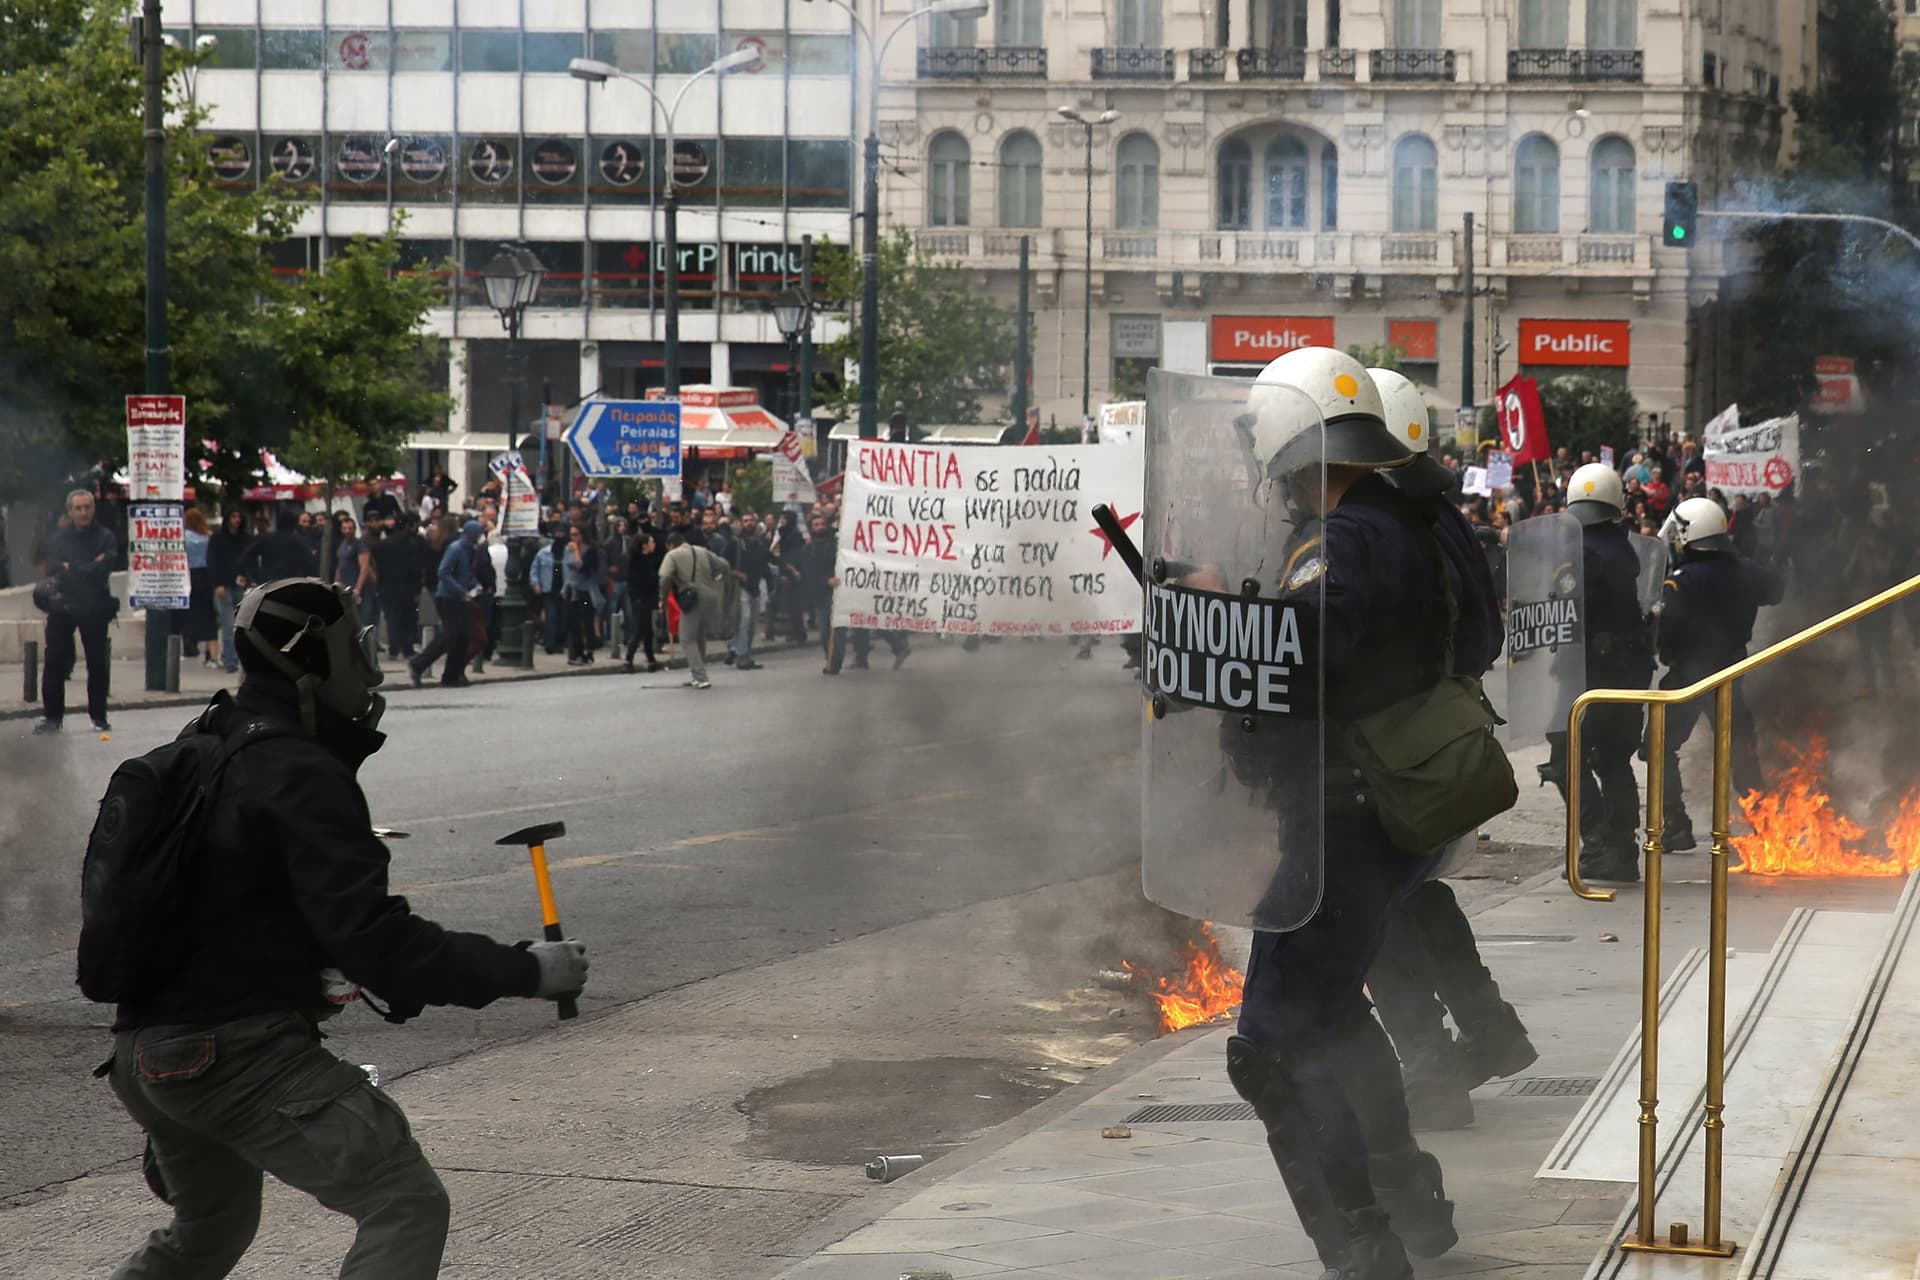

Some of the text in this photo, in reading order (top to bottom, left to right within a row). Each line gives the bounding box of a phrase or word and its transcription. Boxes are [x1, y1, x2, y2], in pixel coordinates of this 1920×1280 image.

[1234, 330, 1311, 348] Public
[1535, 334, 1614, 353] Public
[620, 425, 676, 438] Peiraias
[859, 447, 963, 489] ΕΝΑΝΤΙΑ
[975, 470, 999, 492] σε
[866, 493, 893, 517] και
[971, 541, 1005, 570] για
[1018, 542, 1058, 567] την
[1069, 573, 1105, 595] της
[941, 601, 978, 626] μας
[1508, 623, 1573, 655] POLICE
[1147, 639, 1290, 713] POLICE
